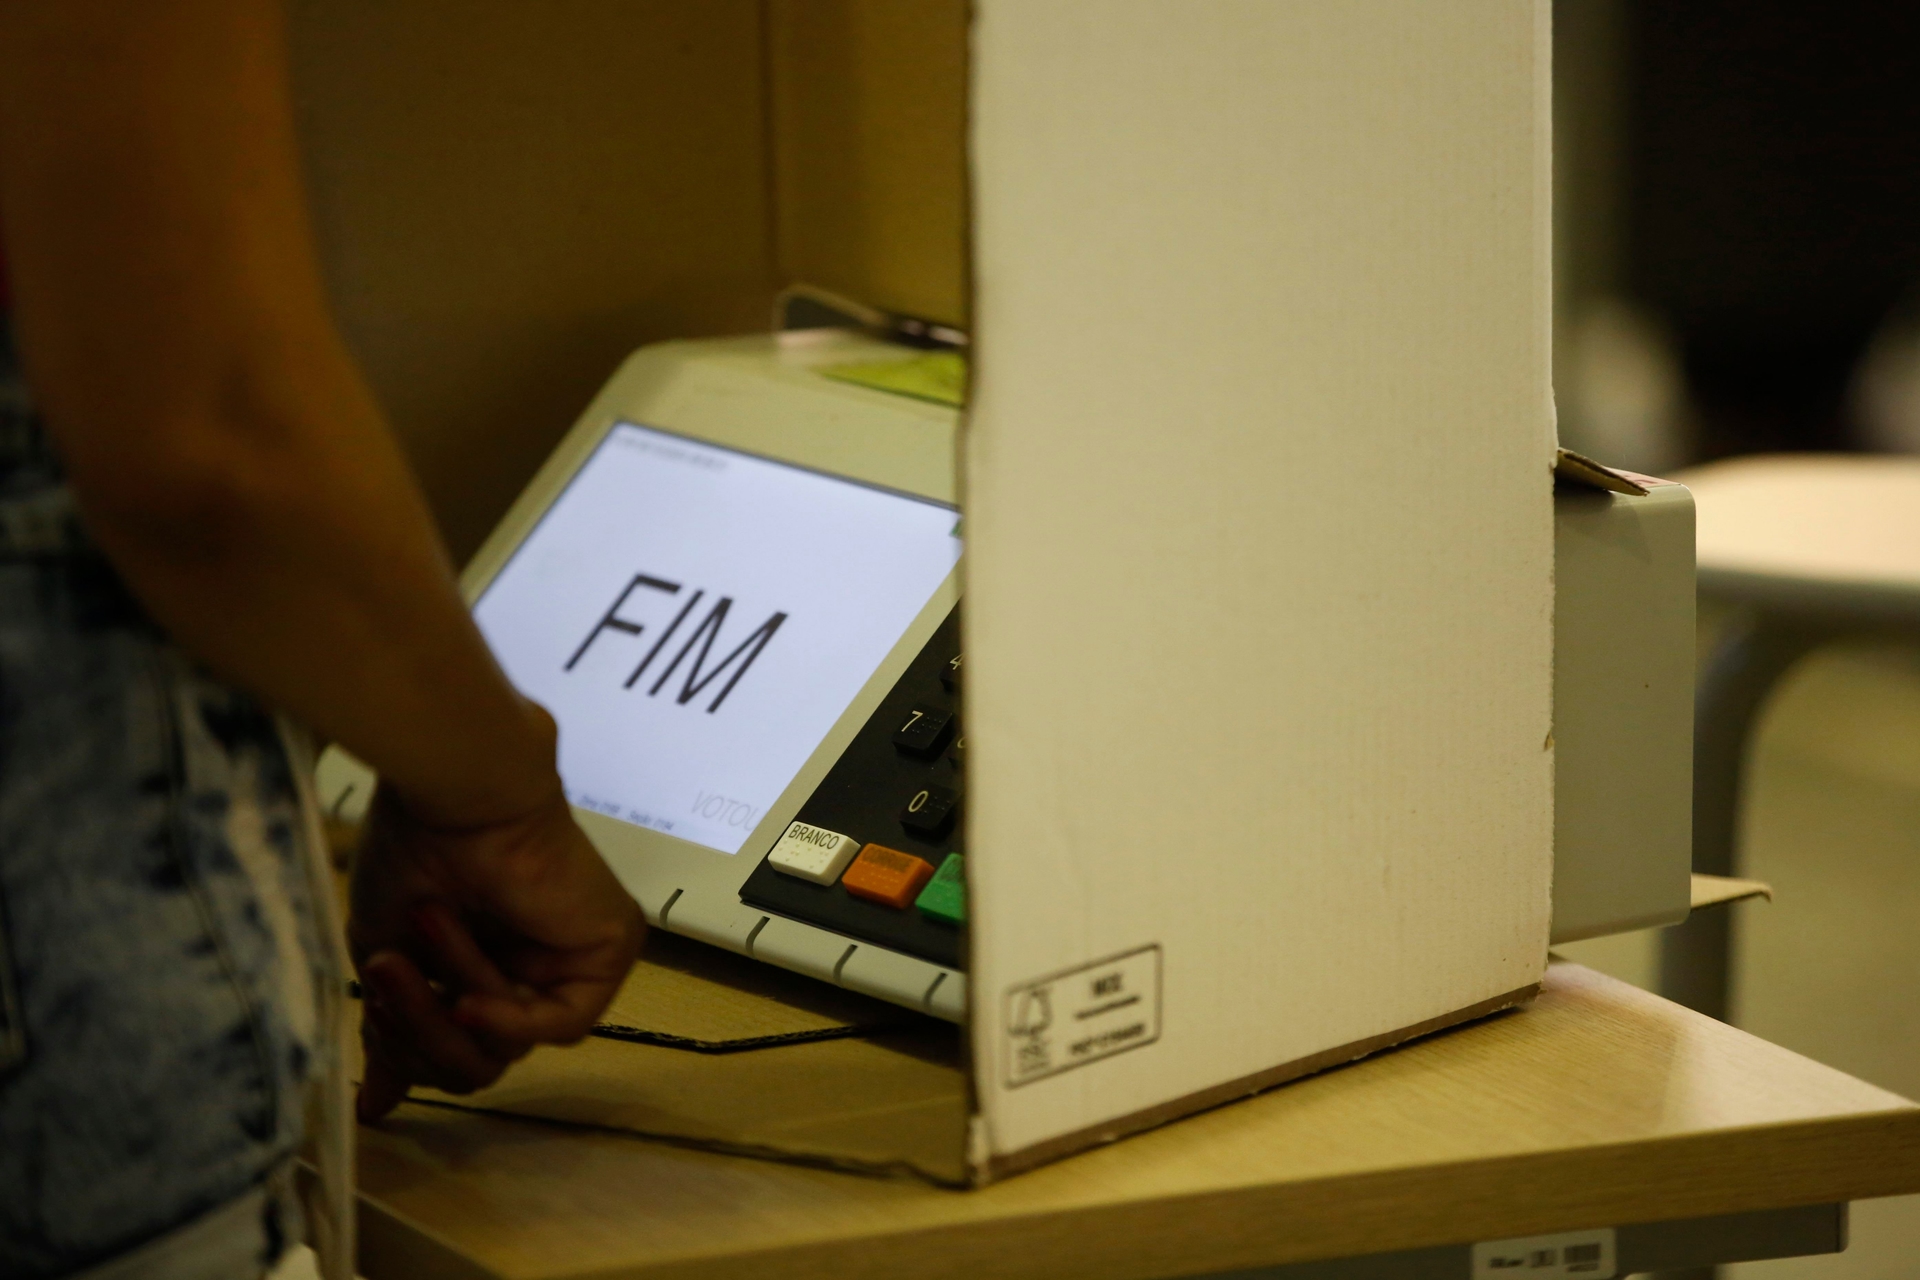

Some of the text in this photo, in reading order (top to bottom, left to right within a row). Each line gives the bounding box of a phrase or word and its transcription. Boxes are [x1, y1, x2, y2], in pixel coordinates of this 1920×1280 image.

[563, 573, 788, 714] FIM
[949, 652, 964, 671] 4
[901, 710, 923, 732] 7
[908, 790, 929, 812] 0
[788, 824, 840, 850] BRANCO
